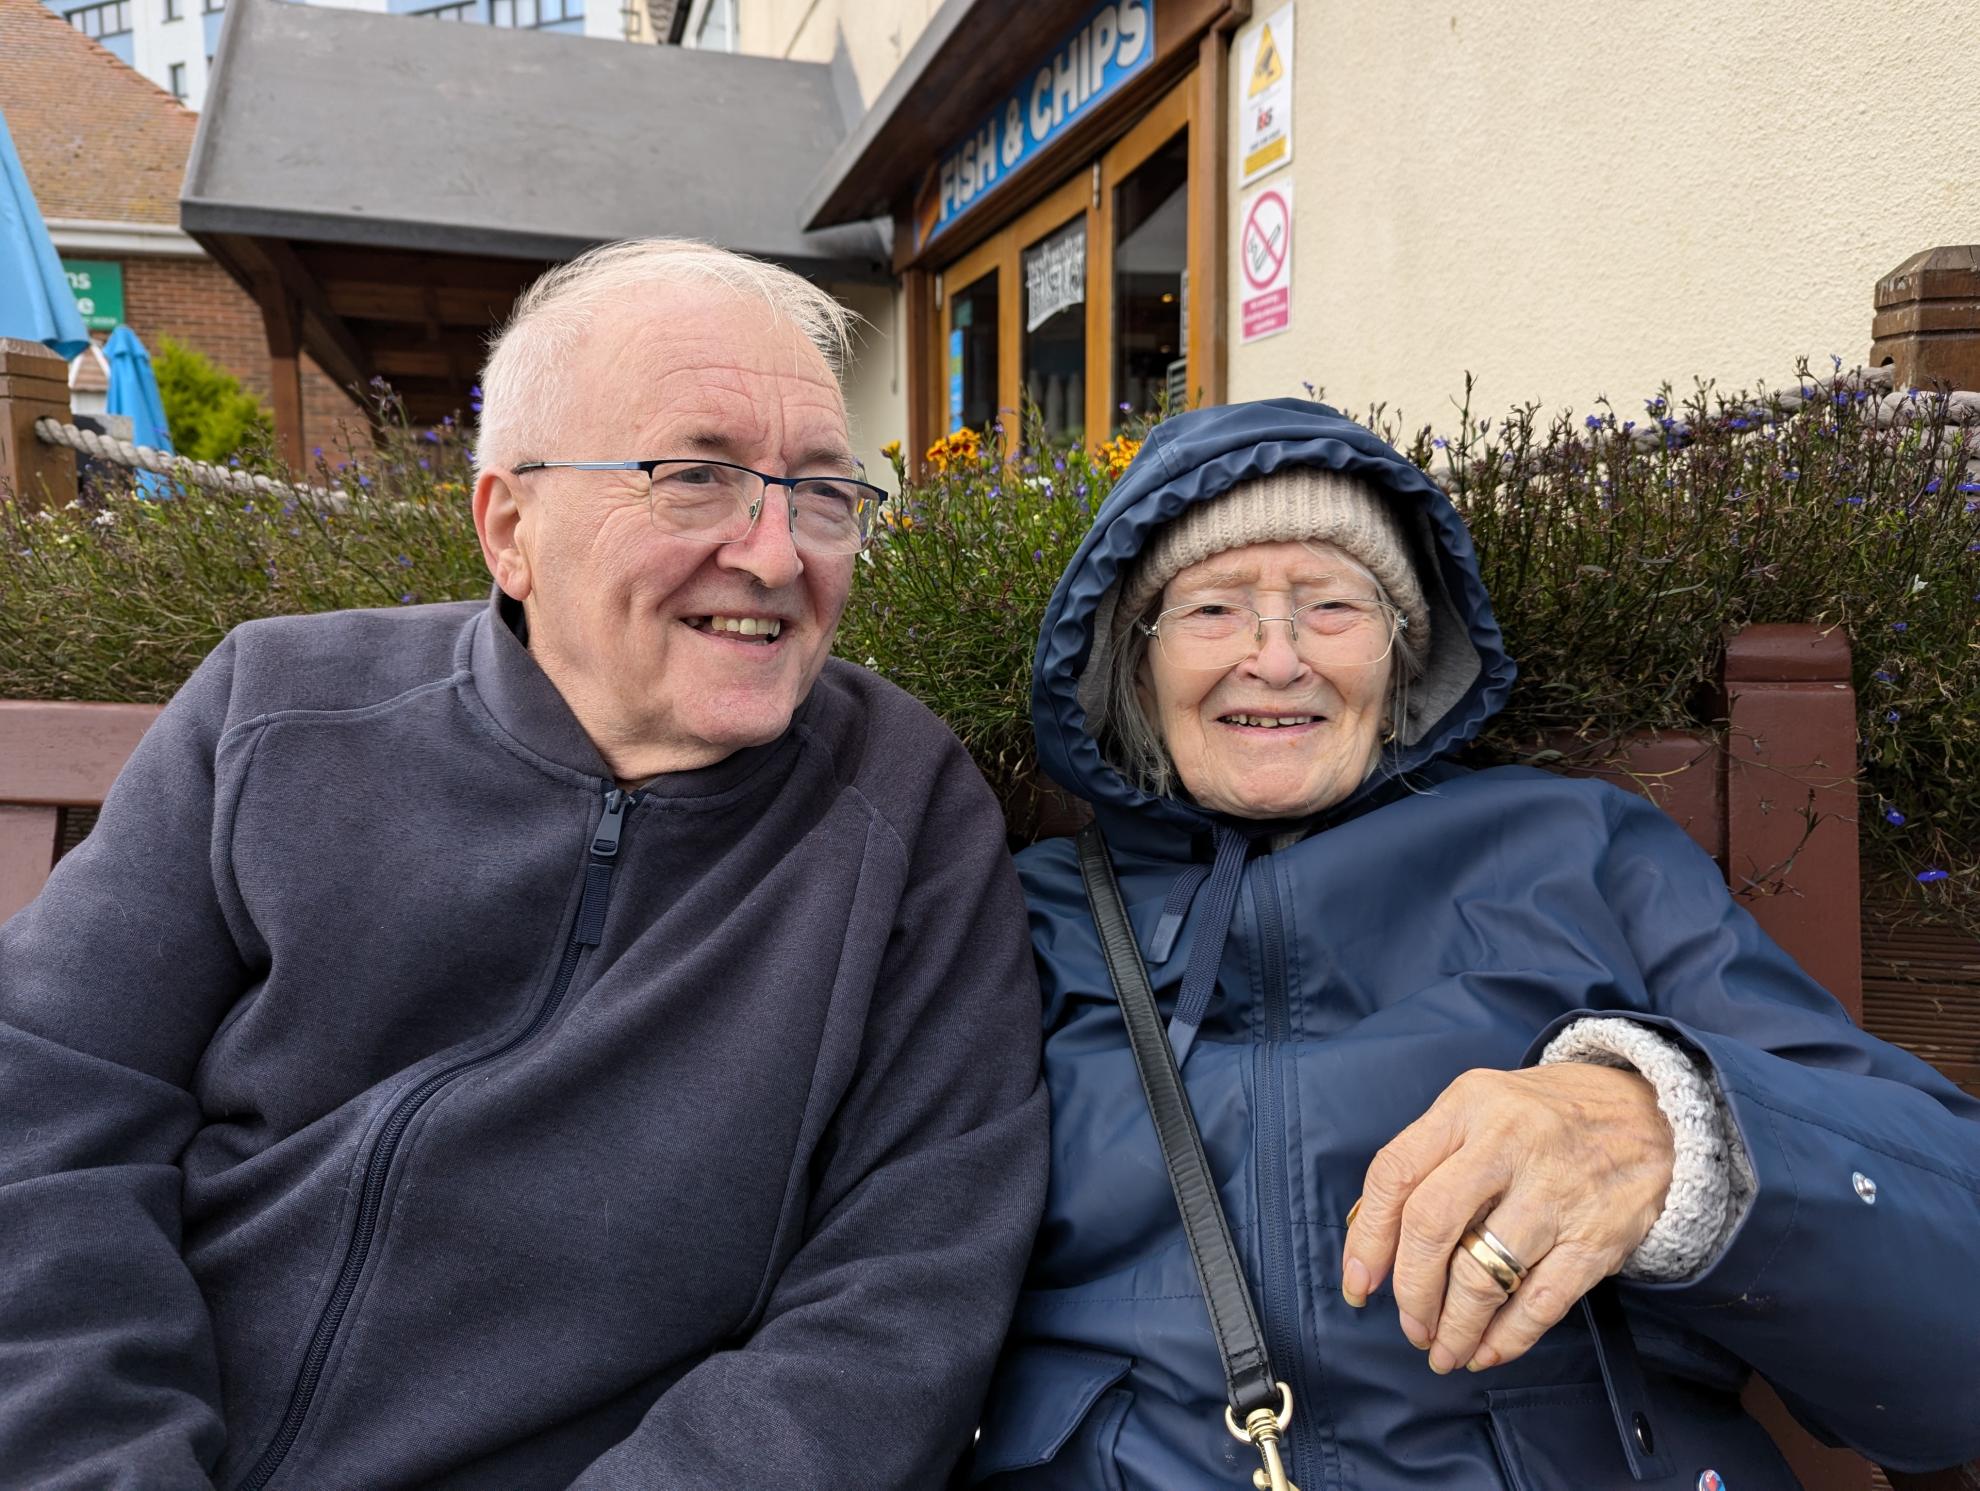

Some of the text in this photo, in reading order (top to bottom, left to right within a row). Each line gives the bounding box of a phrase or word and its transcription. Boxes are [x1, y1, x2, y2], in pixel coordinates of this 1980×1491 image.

[940, 0, 1147, 222] FISH & CHIPS
